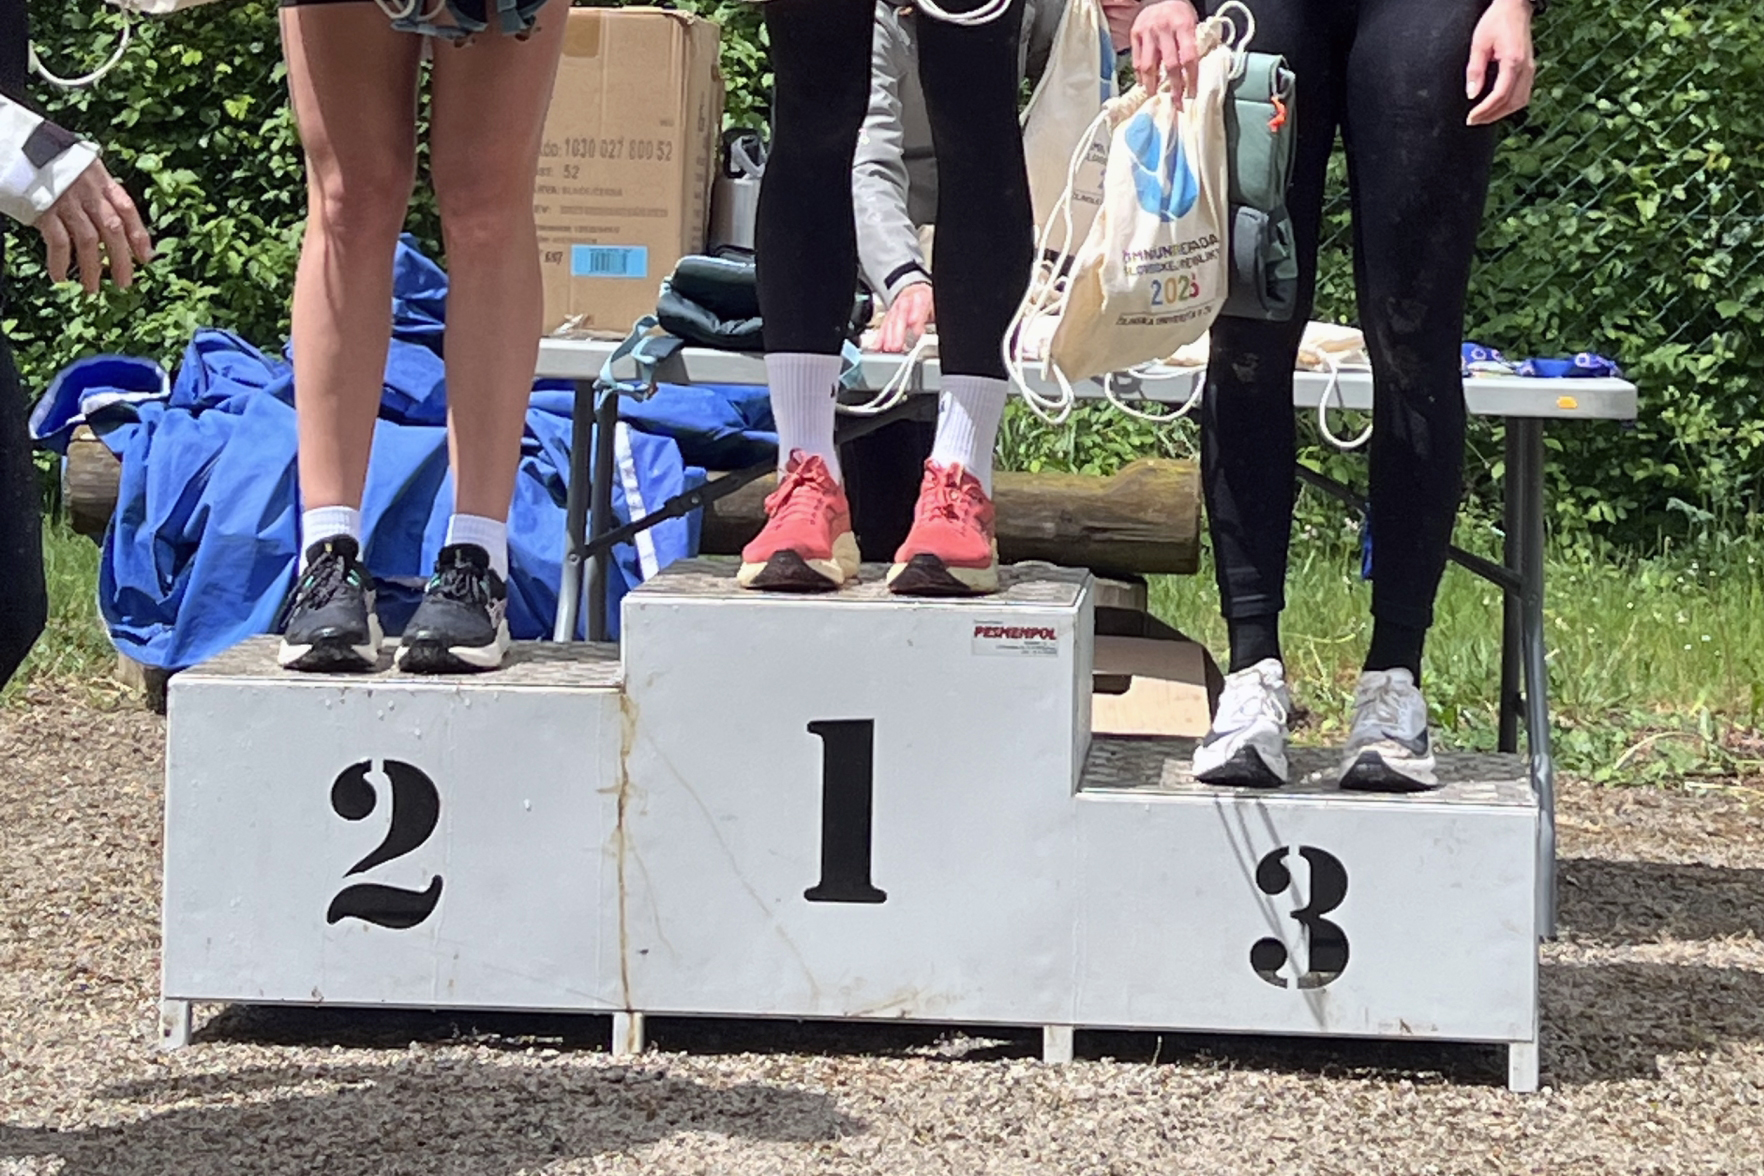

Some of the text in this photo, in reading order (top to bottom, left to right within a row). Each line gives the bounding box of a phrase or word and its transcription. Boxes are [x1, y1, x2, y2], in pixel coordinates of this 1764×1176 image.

[563, 164, 580, 179] 52
[565, 136, 596, 158] 1030
[600, 136, 624, 159] 027
[656, 140, 673, 162] 52
[327, 759, 443, 929] 2
[804, 719, 887, 904] 1
[1250, 845, 1350, 990] 3
